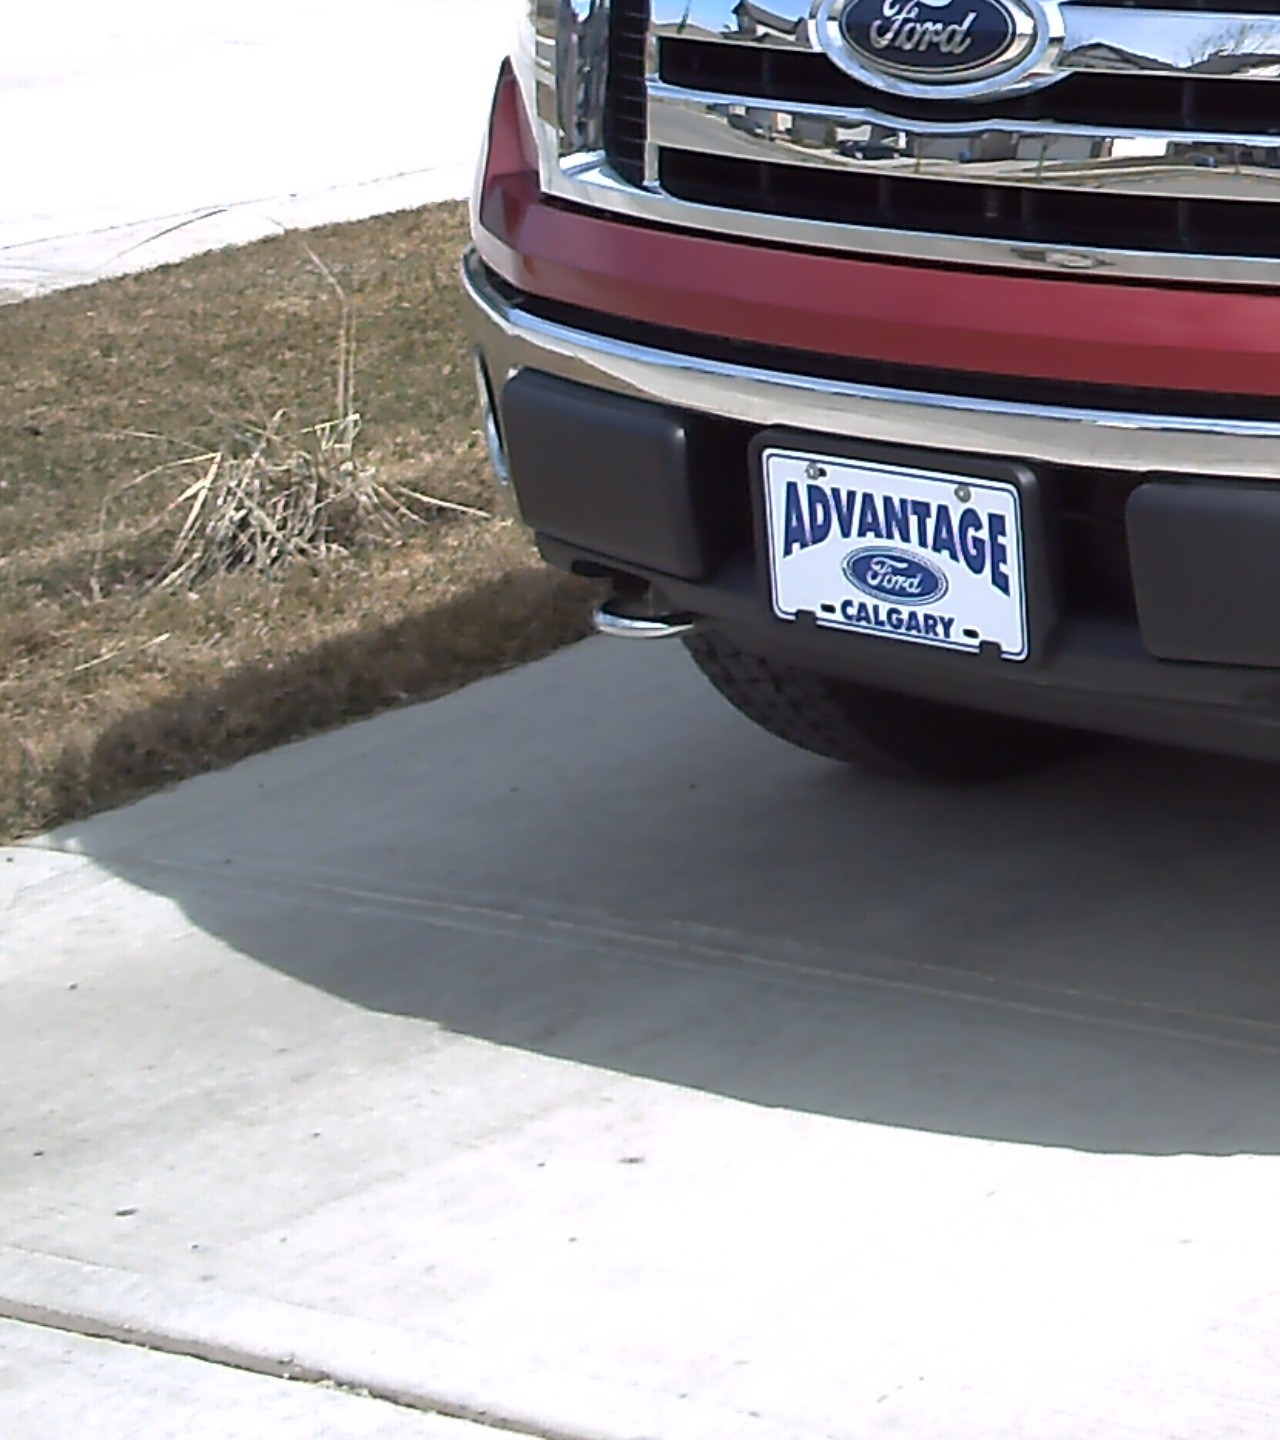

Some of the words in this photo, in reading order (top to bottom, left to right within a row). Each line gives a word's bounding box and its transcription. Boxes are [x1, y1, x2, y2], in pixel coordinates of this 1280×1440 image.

[783, 480, 1011, 597] ADVANTAGE
[866, 556, 922, 594] Ford
[840, 599, 955, 638] CALGARY
